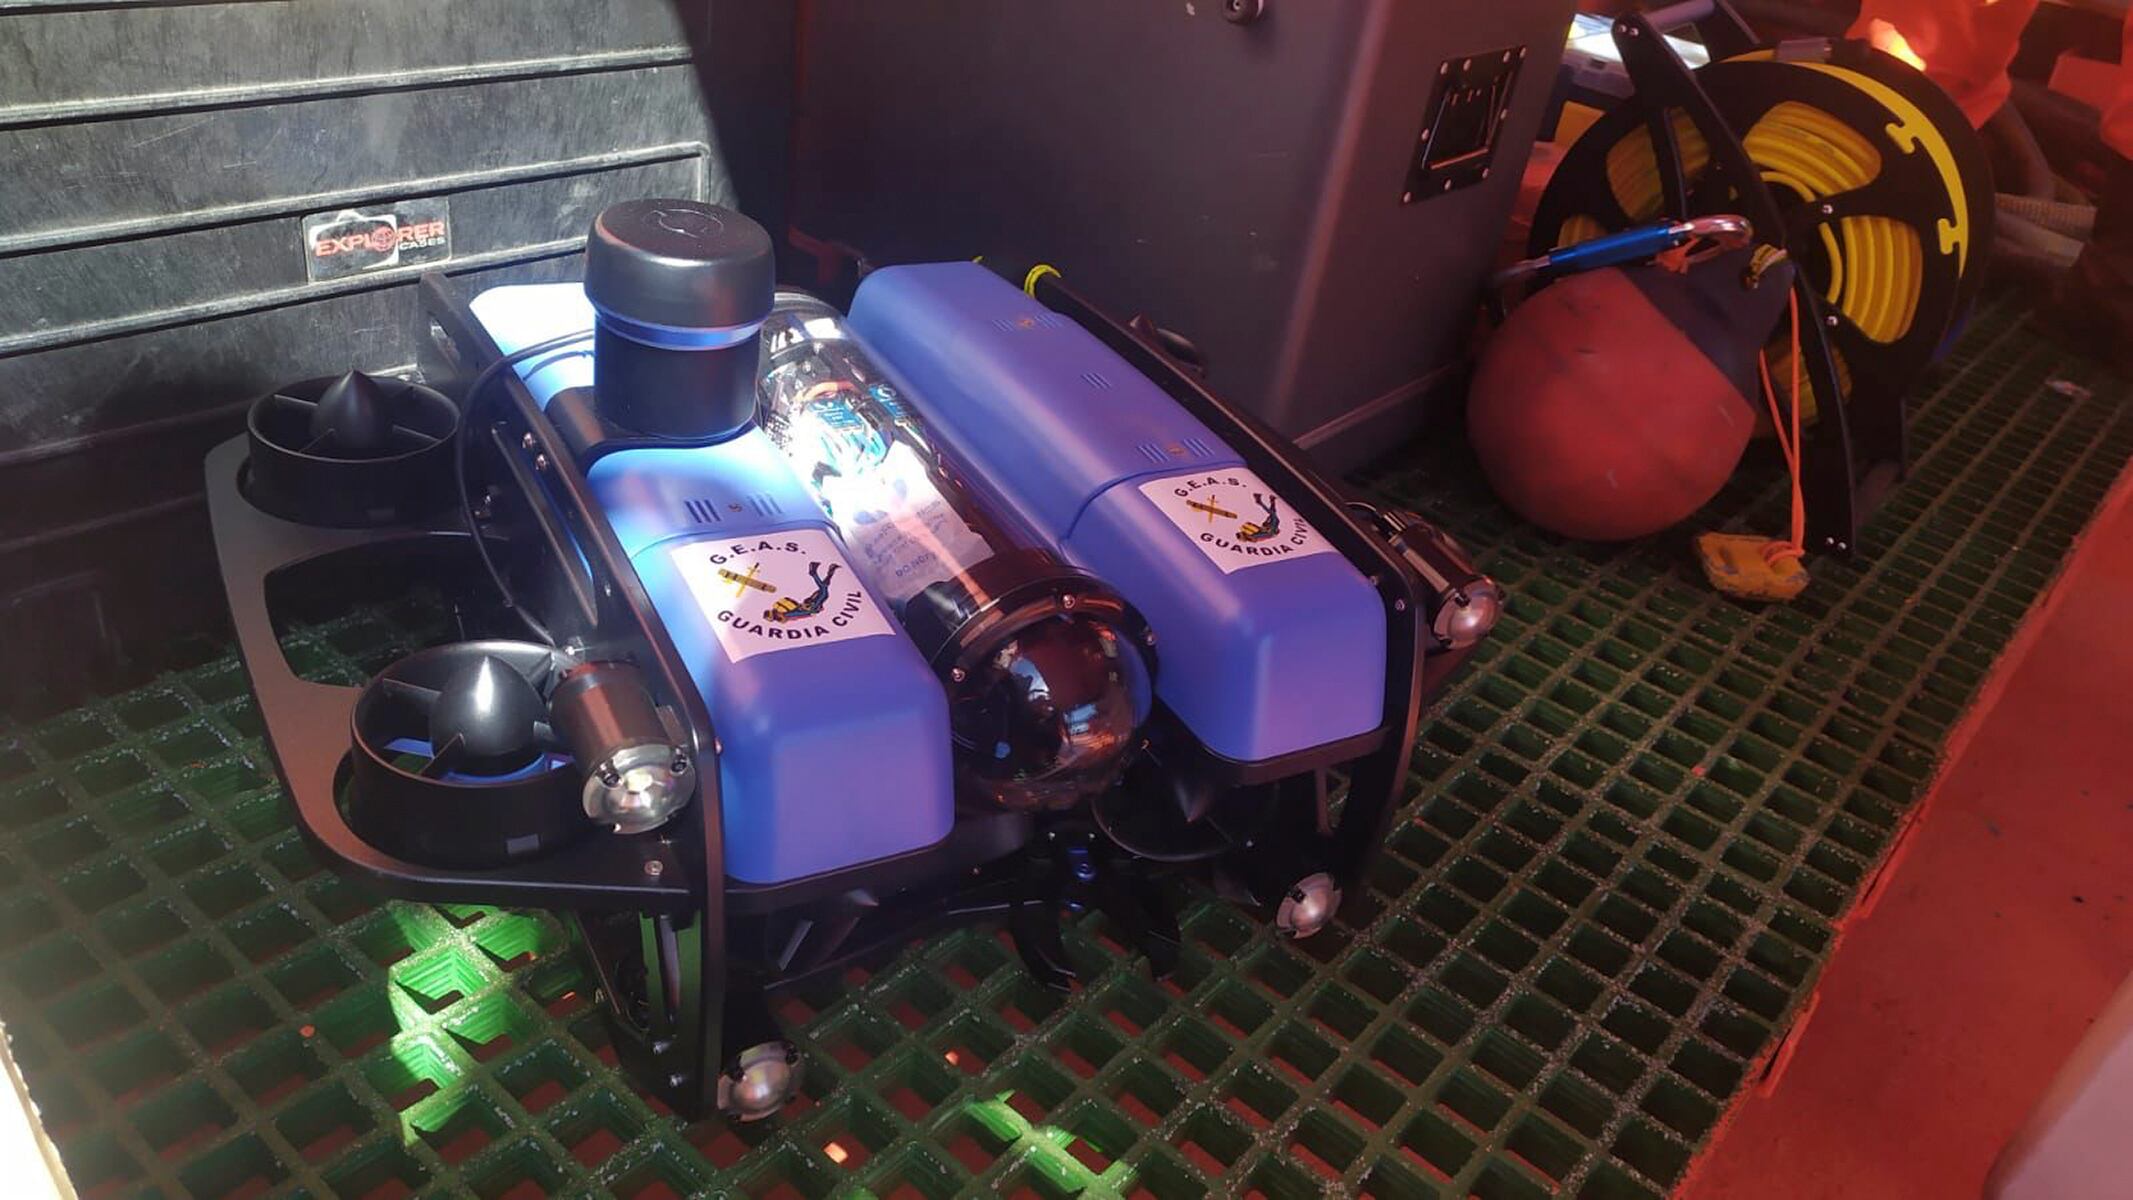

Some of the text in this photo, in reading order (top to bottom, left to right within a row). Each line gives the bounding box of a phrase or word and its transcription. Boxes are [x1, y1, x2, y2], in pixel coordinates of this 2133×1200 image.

[315, 221, 446, 257] EXPLORER
[399, 237, 446, 250] CASES
[1174, 476, 1248, 498] G.E.A.S.
[1200, 517, 1307, 556] GUARDIA CIVIL
[709, 540, 807, 565] G.E.A.S.
[717, 590, 863, 640] GUARDIA CIVIL
